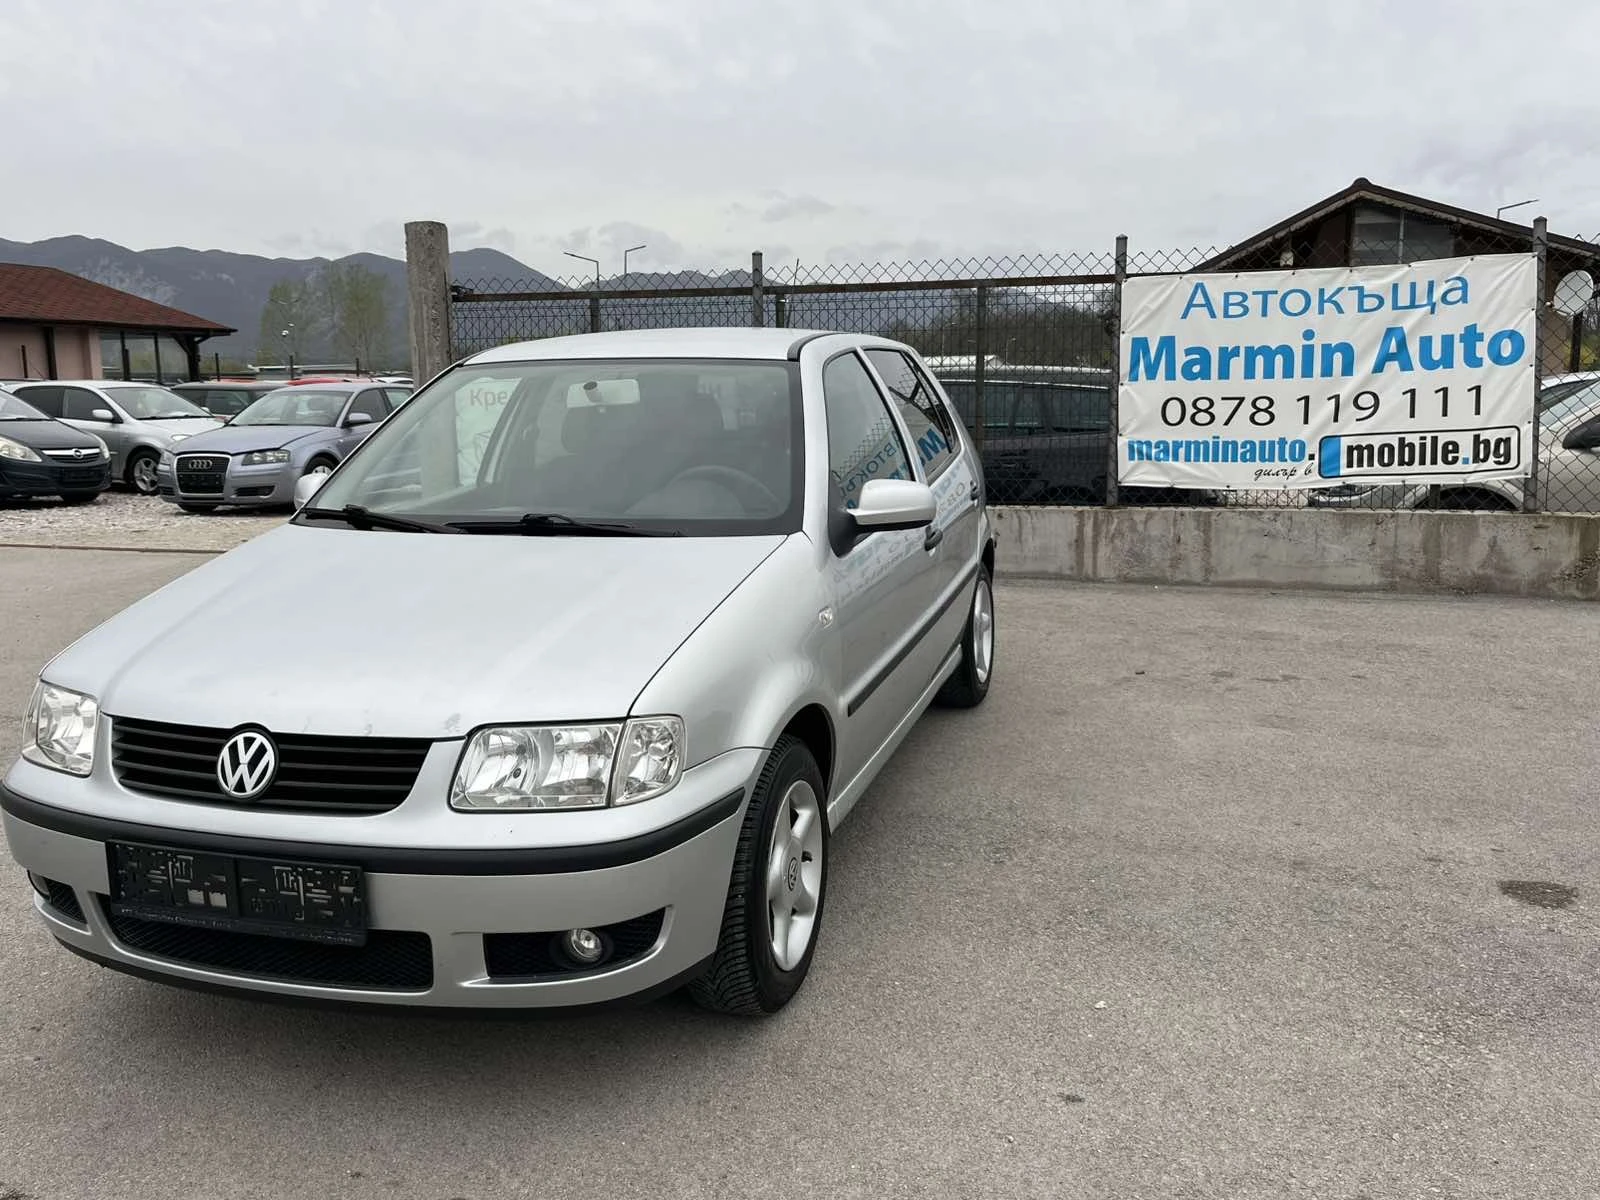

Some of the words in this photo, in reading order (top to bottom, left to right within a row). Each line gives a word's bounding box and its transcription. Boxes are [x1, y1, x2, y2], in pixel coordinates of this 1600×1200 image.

[1180, 275, 1469, 320] Автокъща
[1128, 328, 1355, 382] Marmin
[1371, 323, 1525, 375] Auto
[1160, 395, 1276, 427] 0878
[1296, 390, 1380, 425] 119
[1401, 385, 1482, 419] 111
[1346, 434, 1512, 469] mobile.bg
